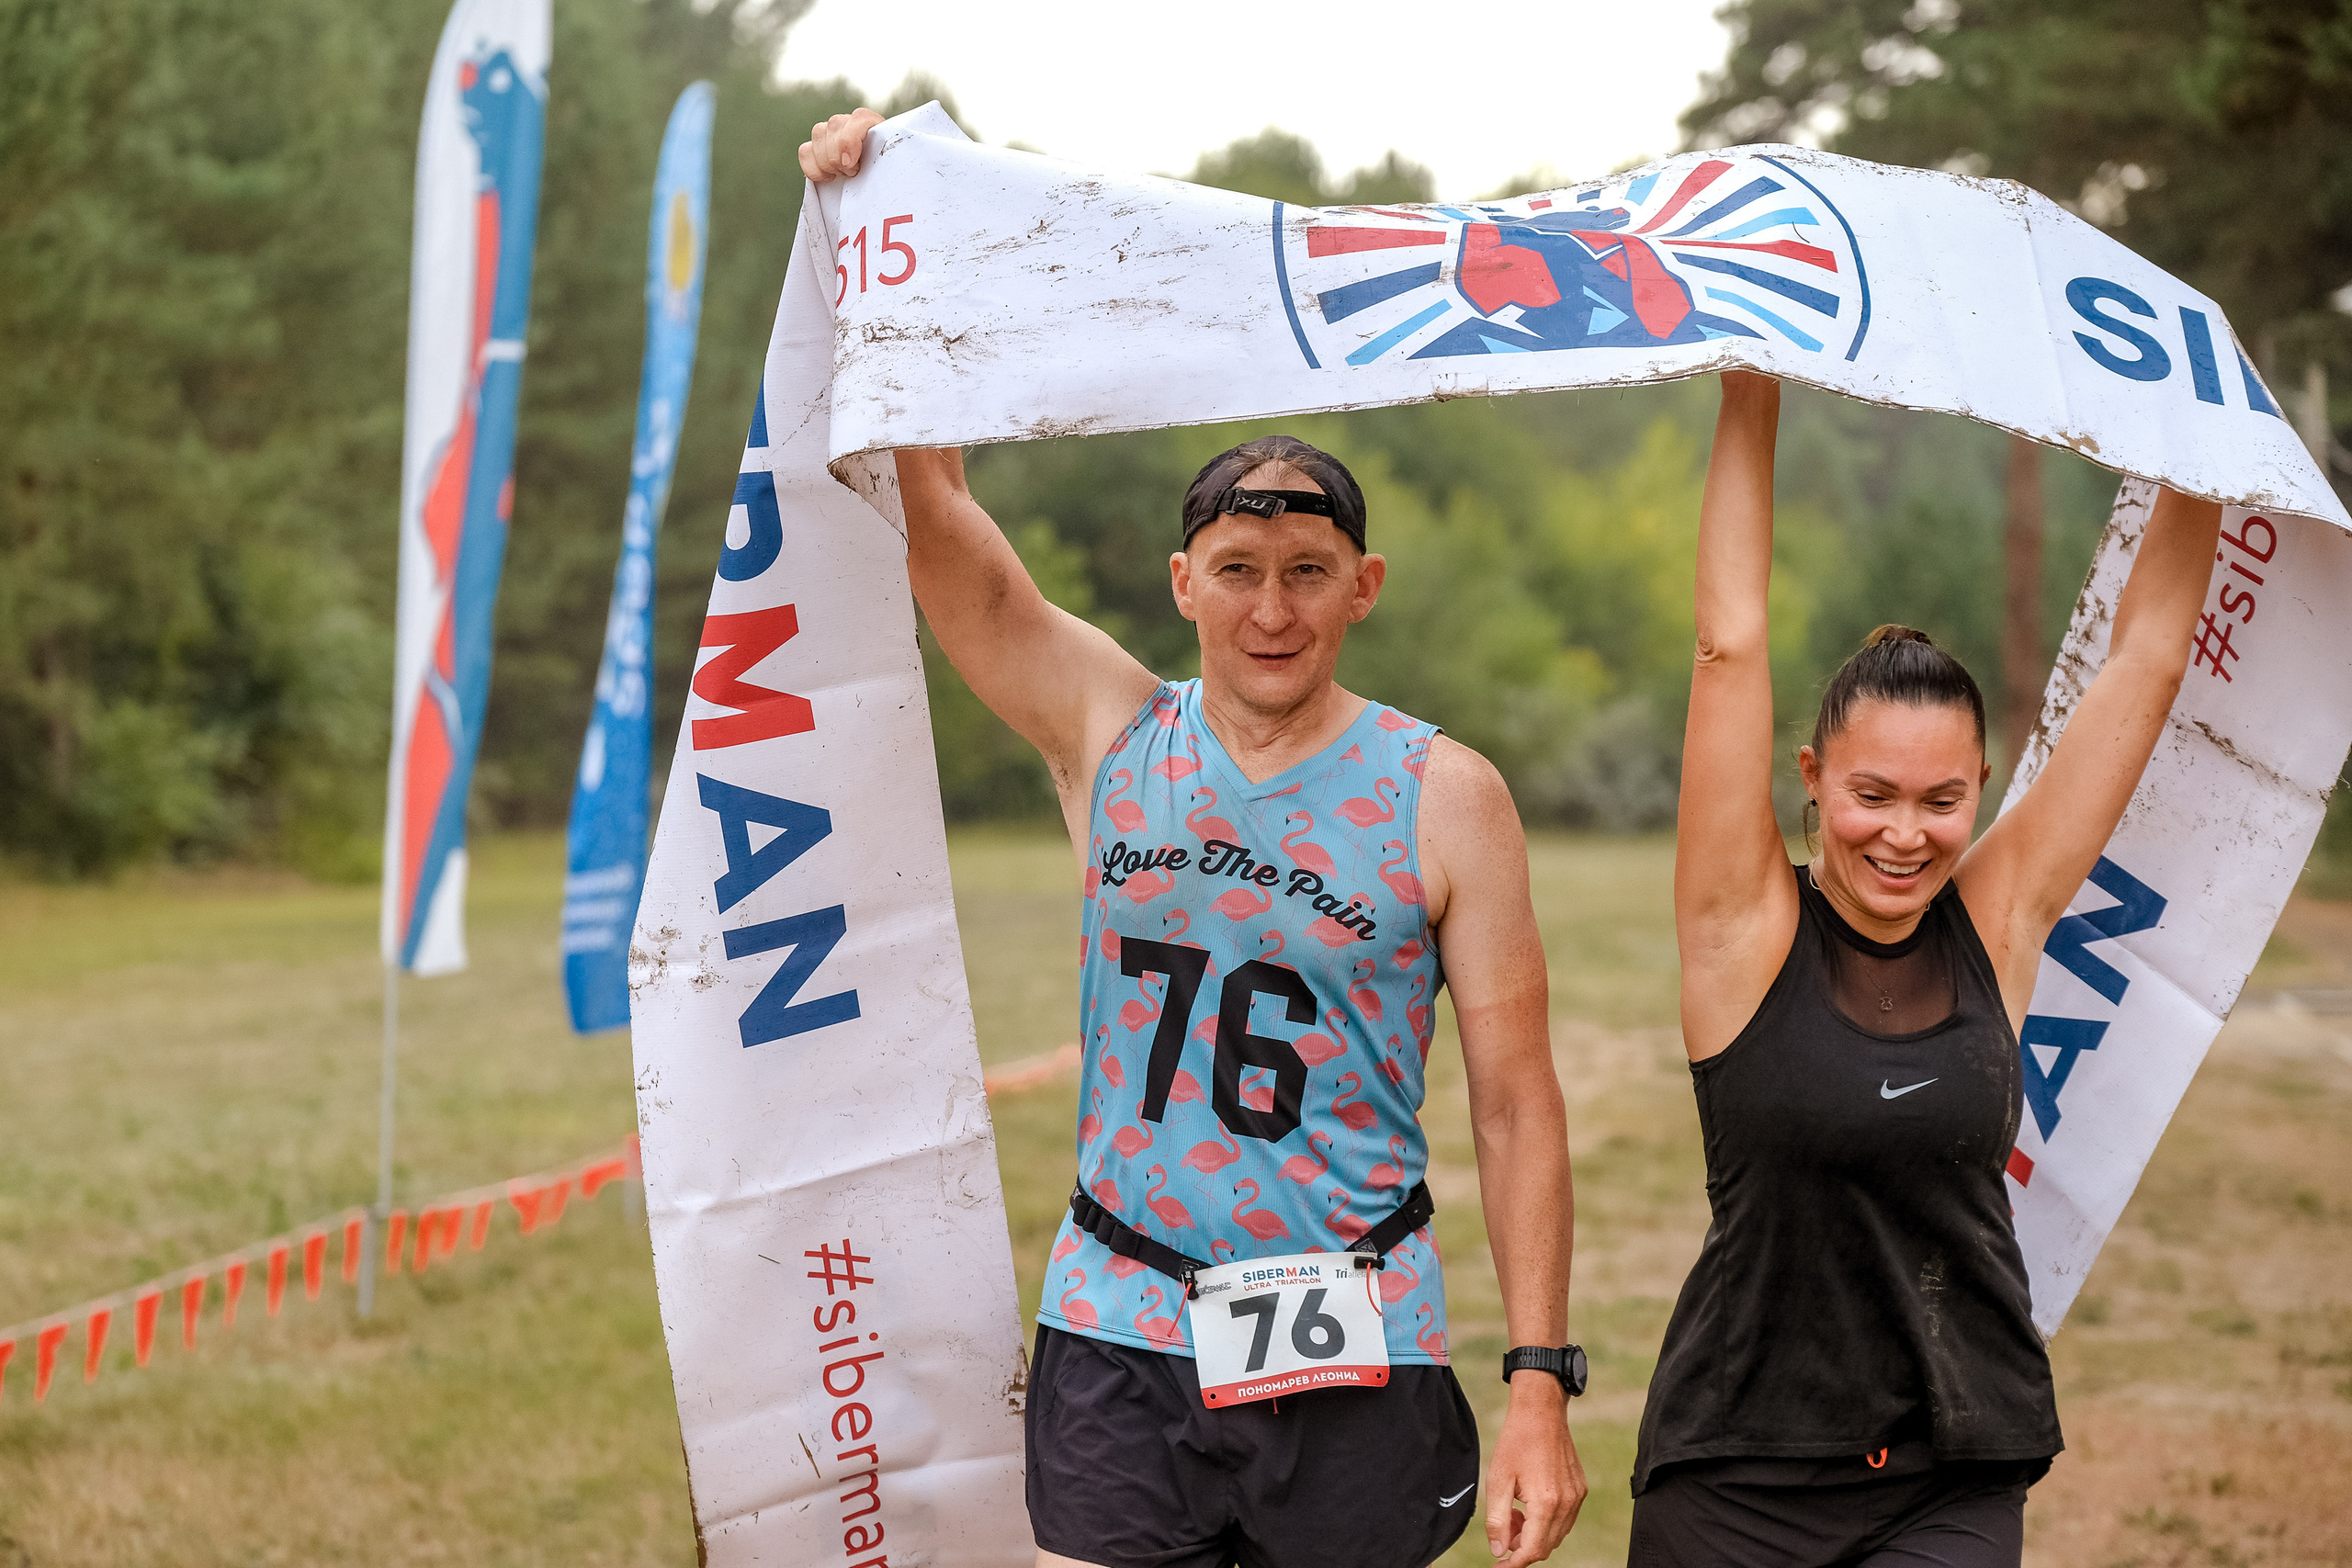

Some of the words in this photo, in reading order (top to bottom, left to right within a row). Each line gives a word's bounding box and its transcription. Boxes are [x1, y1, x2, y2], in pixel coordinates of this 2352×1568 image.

[1102, 840, 1193, 887] Love
[1198, 839, 1281, 887] The
[1283, 868, 1377, 942] Pain
[1120, 935, 1318, 1145] 76
[2005, 854, 2169, 1189] AN
[1242, 1265, 1321, 1284] SIBERMAN
[1243, 1281, 1272, 1292] ULTRA
[1274, 1277, 1322, 1287] TRIATHLON
[1228, 1288, 1346, 1373] 76
[1237, 1375, 1311, 1398] ПОНОМАРЕВ
[1311, 1371, 1362, 1384] ЛЕОНИД
